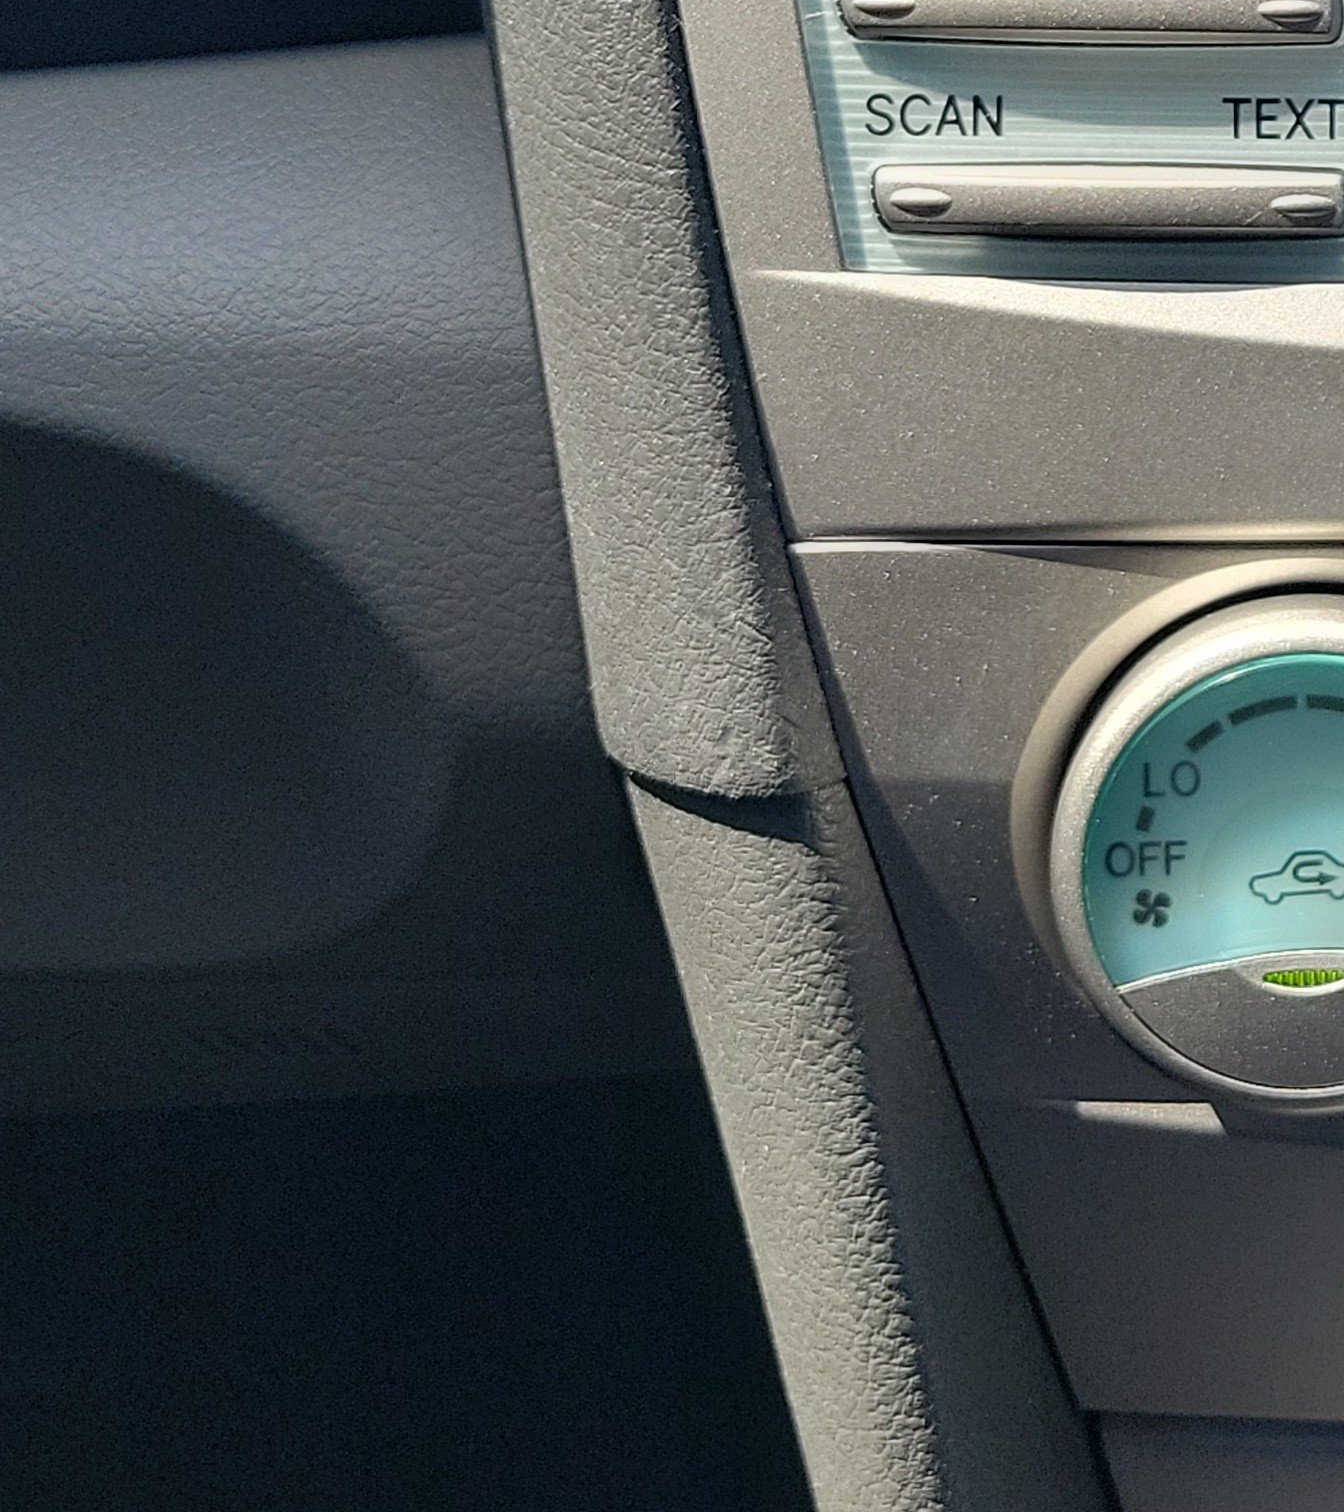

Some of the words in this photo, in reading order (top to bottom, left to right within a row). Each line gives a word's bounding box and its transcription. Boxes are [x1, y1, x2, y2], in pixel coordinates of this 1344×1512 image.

[864, 94, 1004, 137] SCAN
[1142, 759, 1200, 798] LO
[1104, 839, 1188, 879] OFF
